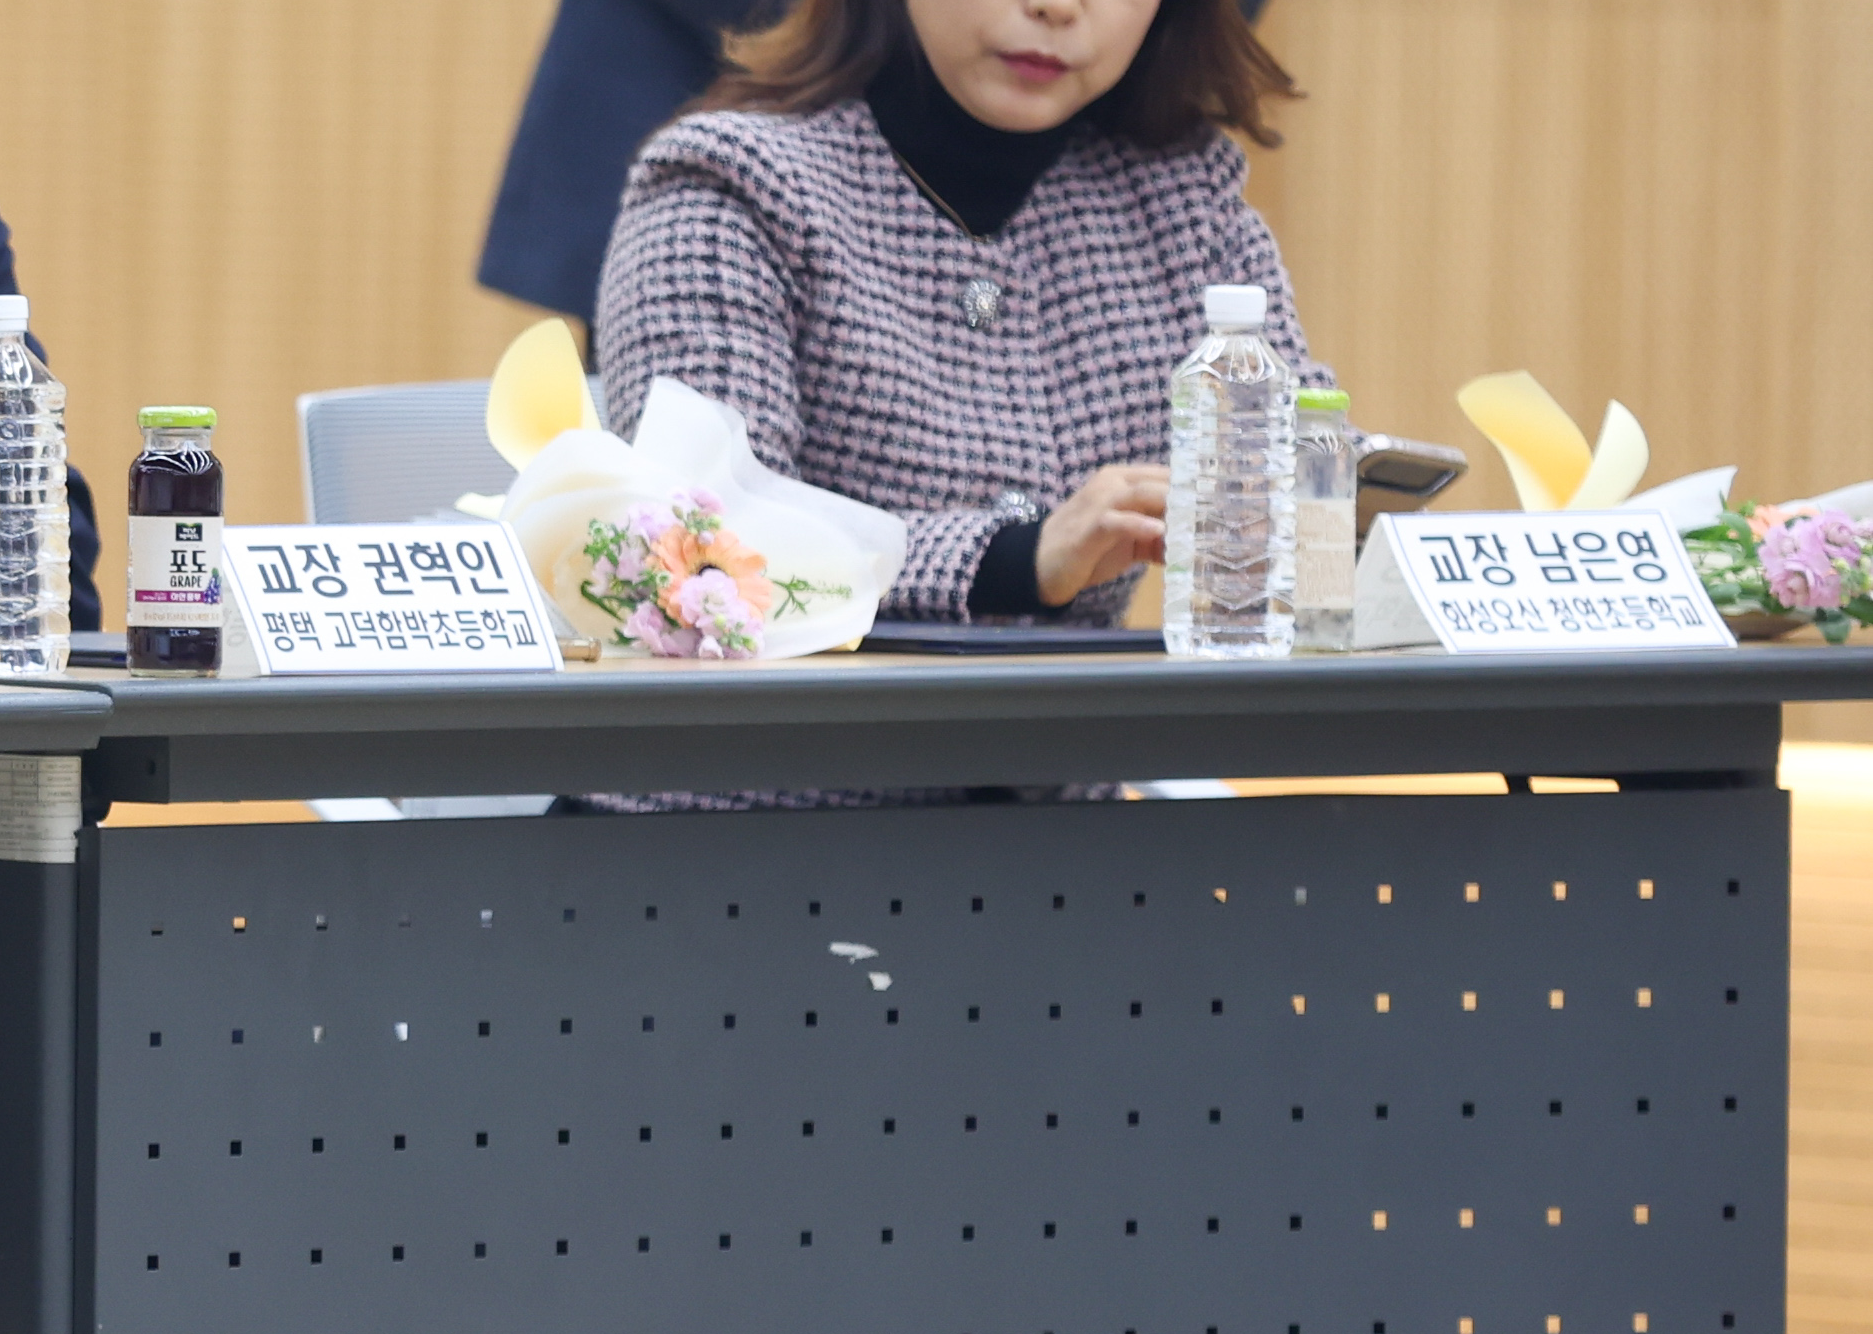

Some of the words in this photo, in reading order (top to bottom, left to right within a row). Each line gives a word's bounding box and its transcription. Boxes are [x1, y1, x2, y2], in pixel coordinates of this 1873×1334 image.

[170, 550, 207, 573] 포도
[247, 544, 348, 598] 교장
[358, 541, 509, 595] 권혁인
[1419, 532, 1516, 587] 교장
[1525, 531, 1668, 584] 남은영
[170, 575, 202, 588] GRAPE
[262, 611, 322, 652] 평택
[325, 609, 538, 650] 고덕함박초등학교
[1440, 597, 1549, 634] 화성오산
[1547, 595, 1704, 632] 청연초등학교
